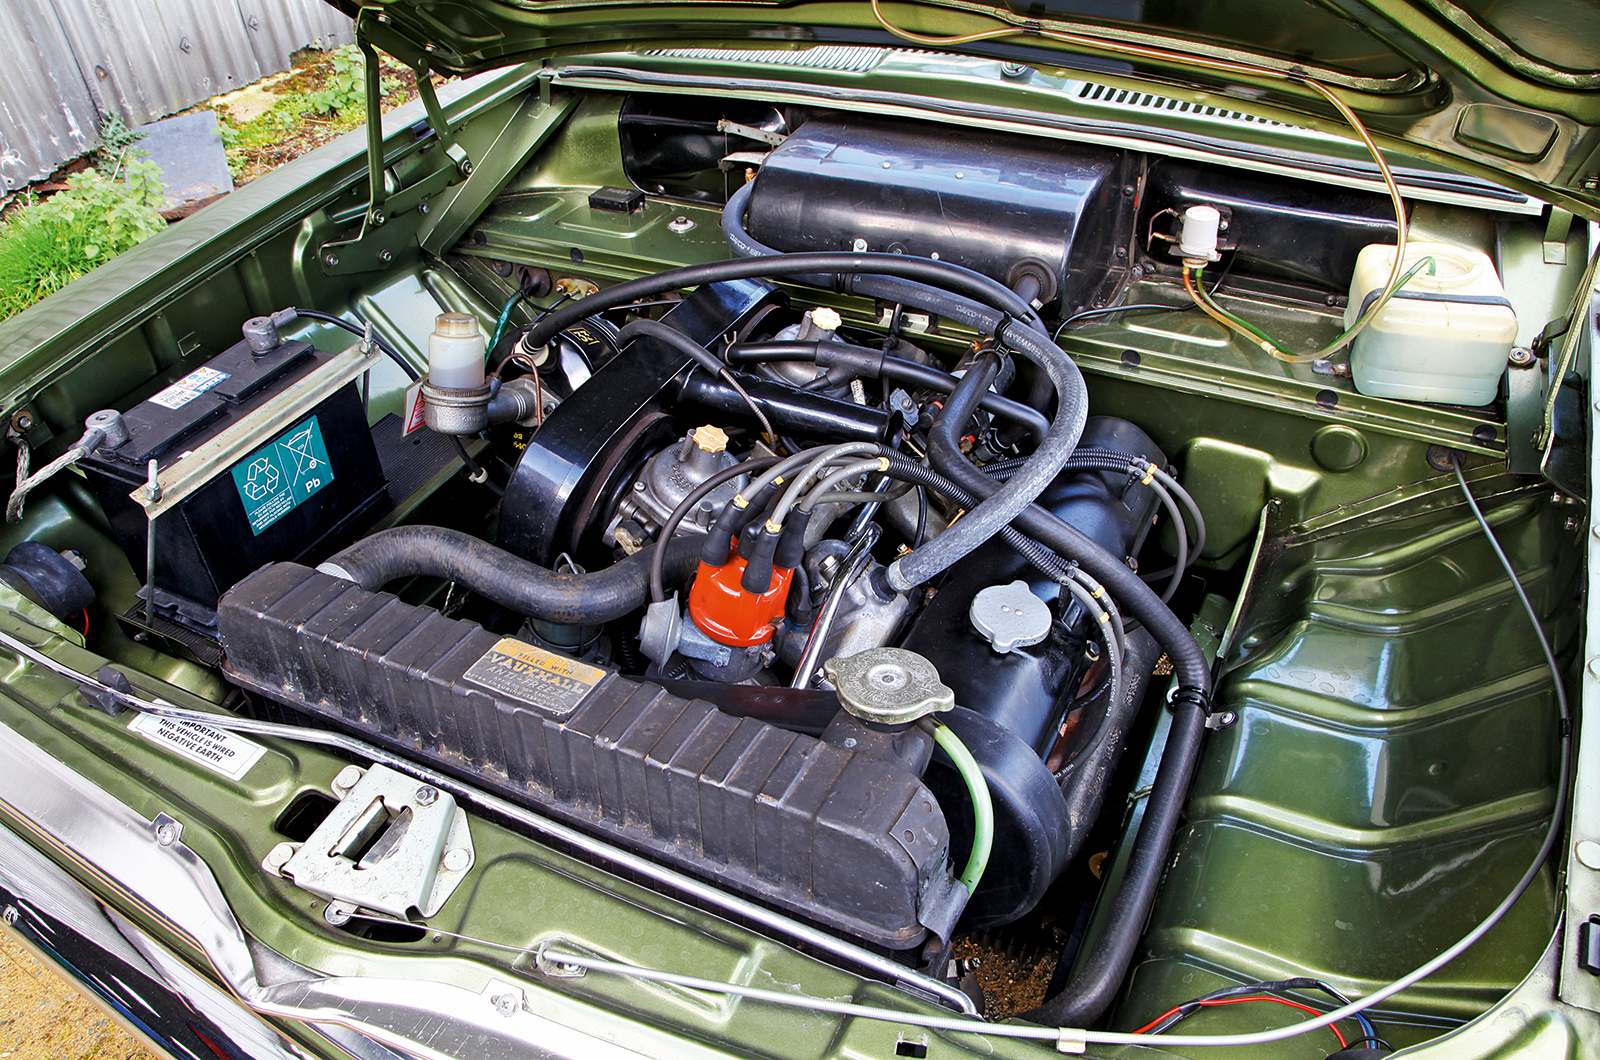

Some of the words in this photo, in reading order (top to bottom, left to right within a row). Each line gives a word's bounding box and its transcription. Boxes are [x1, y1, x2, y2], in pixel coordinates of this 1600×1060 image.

[305, 478, 320, 492] Pb
[510, 642, 527, 652] DO
[528, 649, 554, 661] NOT
[518, 652, 545, 666] FILLED
[551, 665, 573, 676] WITH
[487, 666, 572, 699] ANTI-FREEZE
[490, 653, 584, 694] VAUXHALL
[157, 728, 195, 750] NEGATIVE
[195, 745, 222, 762] EARTH
[159, 719, 176, 730] THIS
[176, 726, 203, 743] VEHICLE
[212, 743, 235, 757] WIRED
[180, 720, 226, 742] IMPORTANT
